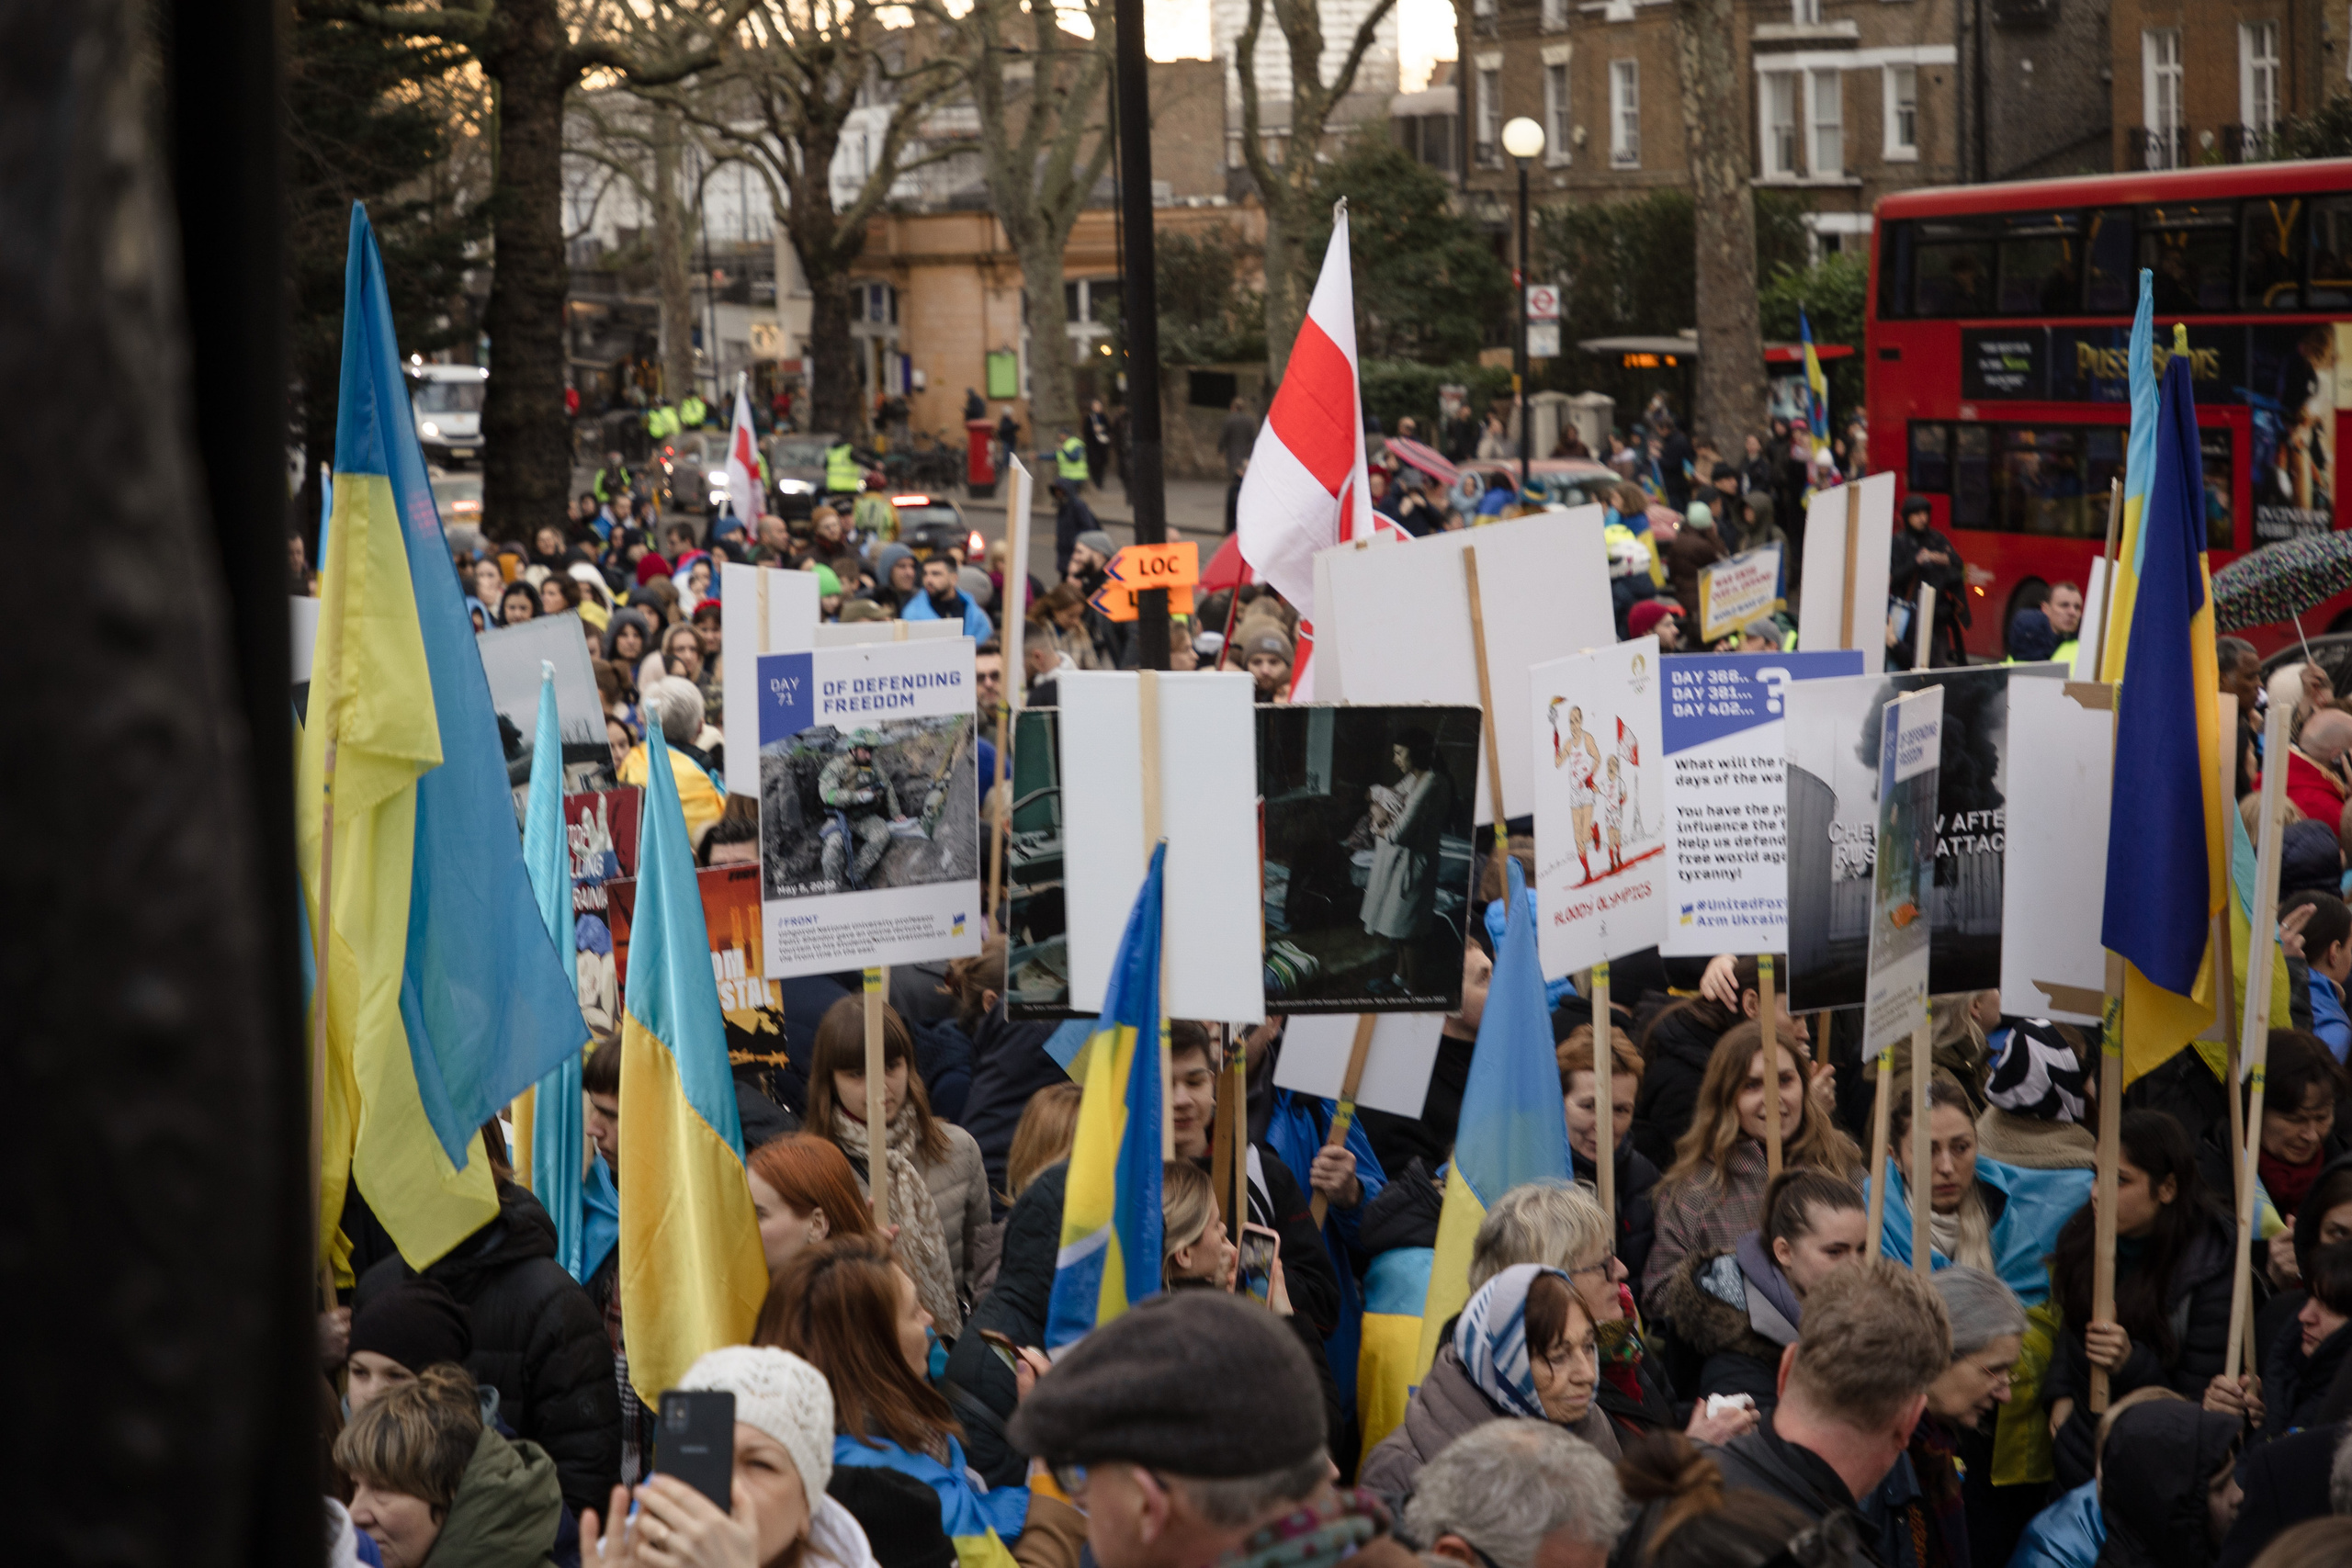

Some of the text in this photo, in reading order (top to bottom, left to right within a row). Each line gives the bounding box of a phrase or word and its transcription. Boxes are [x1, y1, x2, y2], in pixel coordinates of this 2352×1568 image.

[1139, 556, 1180, 576] LOC
[770, 676, 800, 693] DAY
[823, 671, 962, 696] OF DEFENDING
[1671, 670, 1705, 685] DAY
[1671, 685, 1705, 702] DAY
[823, 693, 915, 715] FREEDOM
[1672, 702, 1706, 717] DAY
[1674, 758, 1713, 770] What
[1717, 755, 1747, 770] will
[1749, 755, 1775, 768] the
[1675, 772, 1787, 788] days of the wa
[1676, 806, 1703, 818] You
[1706, 804, 1742, 818] have
[1745, 803, 1770, 816] the
[1677, 819, 1749, 833] influence
[1752, 818, 1778, 831] the
[1951, 809, 2005, 832] AFTE
[1677, 834, 1786, 852] Help us defend
[1935, 833, 2005, 858] ATTAC
[1677, 852, 1711, 864] free
[1714, 851, 1759, 863] world
[1677, 866, 1743, 883] tyranny!
[1697, 897, 1787, 911] #UnitedFor
[1697, 912, 1788, 927] Arm Ukrain
